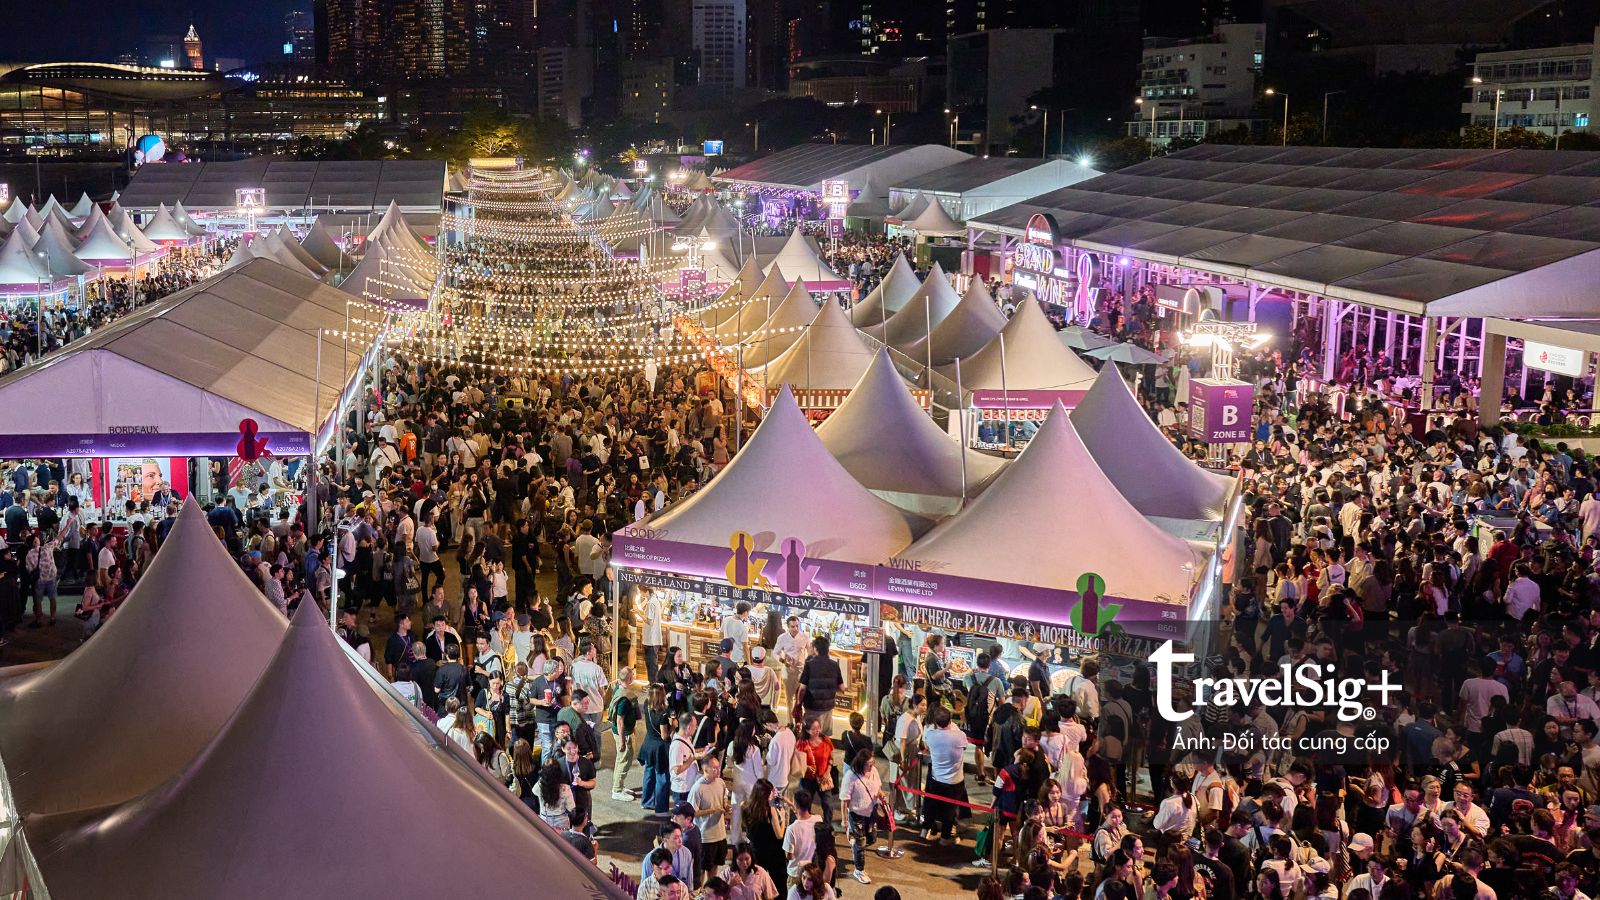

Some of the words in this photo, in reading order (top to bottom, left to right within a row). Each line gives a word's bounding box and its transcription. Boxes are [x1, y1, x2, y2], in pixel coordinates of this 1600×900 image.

[832, 185, 843, 197] B
[1015, 242, 1053, 274] GRAND
[1035, 273, 1069, 307] WINE
[1222, 405, 1238, 426] B
[109, 426, 159, 434] BORDEAUX
[1213, 430, 1237, 439] ZONE
[624, 527, 655, 539] FOOD
[625, 552, 645, 560] MOTHER
[889, 557, 921, 571] WINE
[621, 573, 643, 583] NEW
[645, 576, 691, 590] ZEALAND
[849, 582, 867, 591] B602
[888, 585, 904, 593] LEVIN
[905, 587, 921, 595] WINE
[921, 589, 933, 597] LTD
[786, 597, 811, 608] NEW
[814, 600, 865, 614] ZEALAND
[902, 604, 951, 629] MOTHER
[965, 613, 1016, 638] PIZZAS
[1040, 625, 1093, 650] MOTHER
